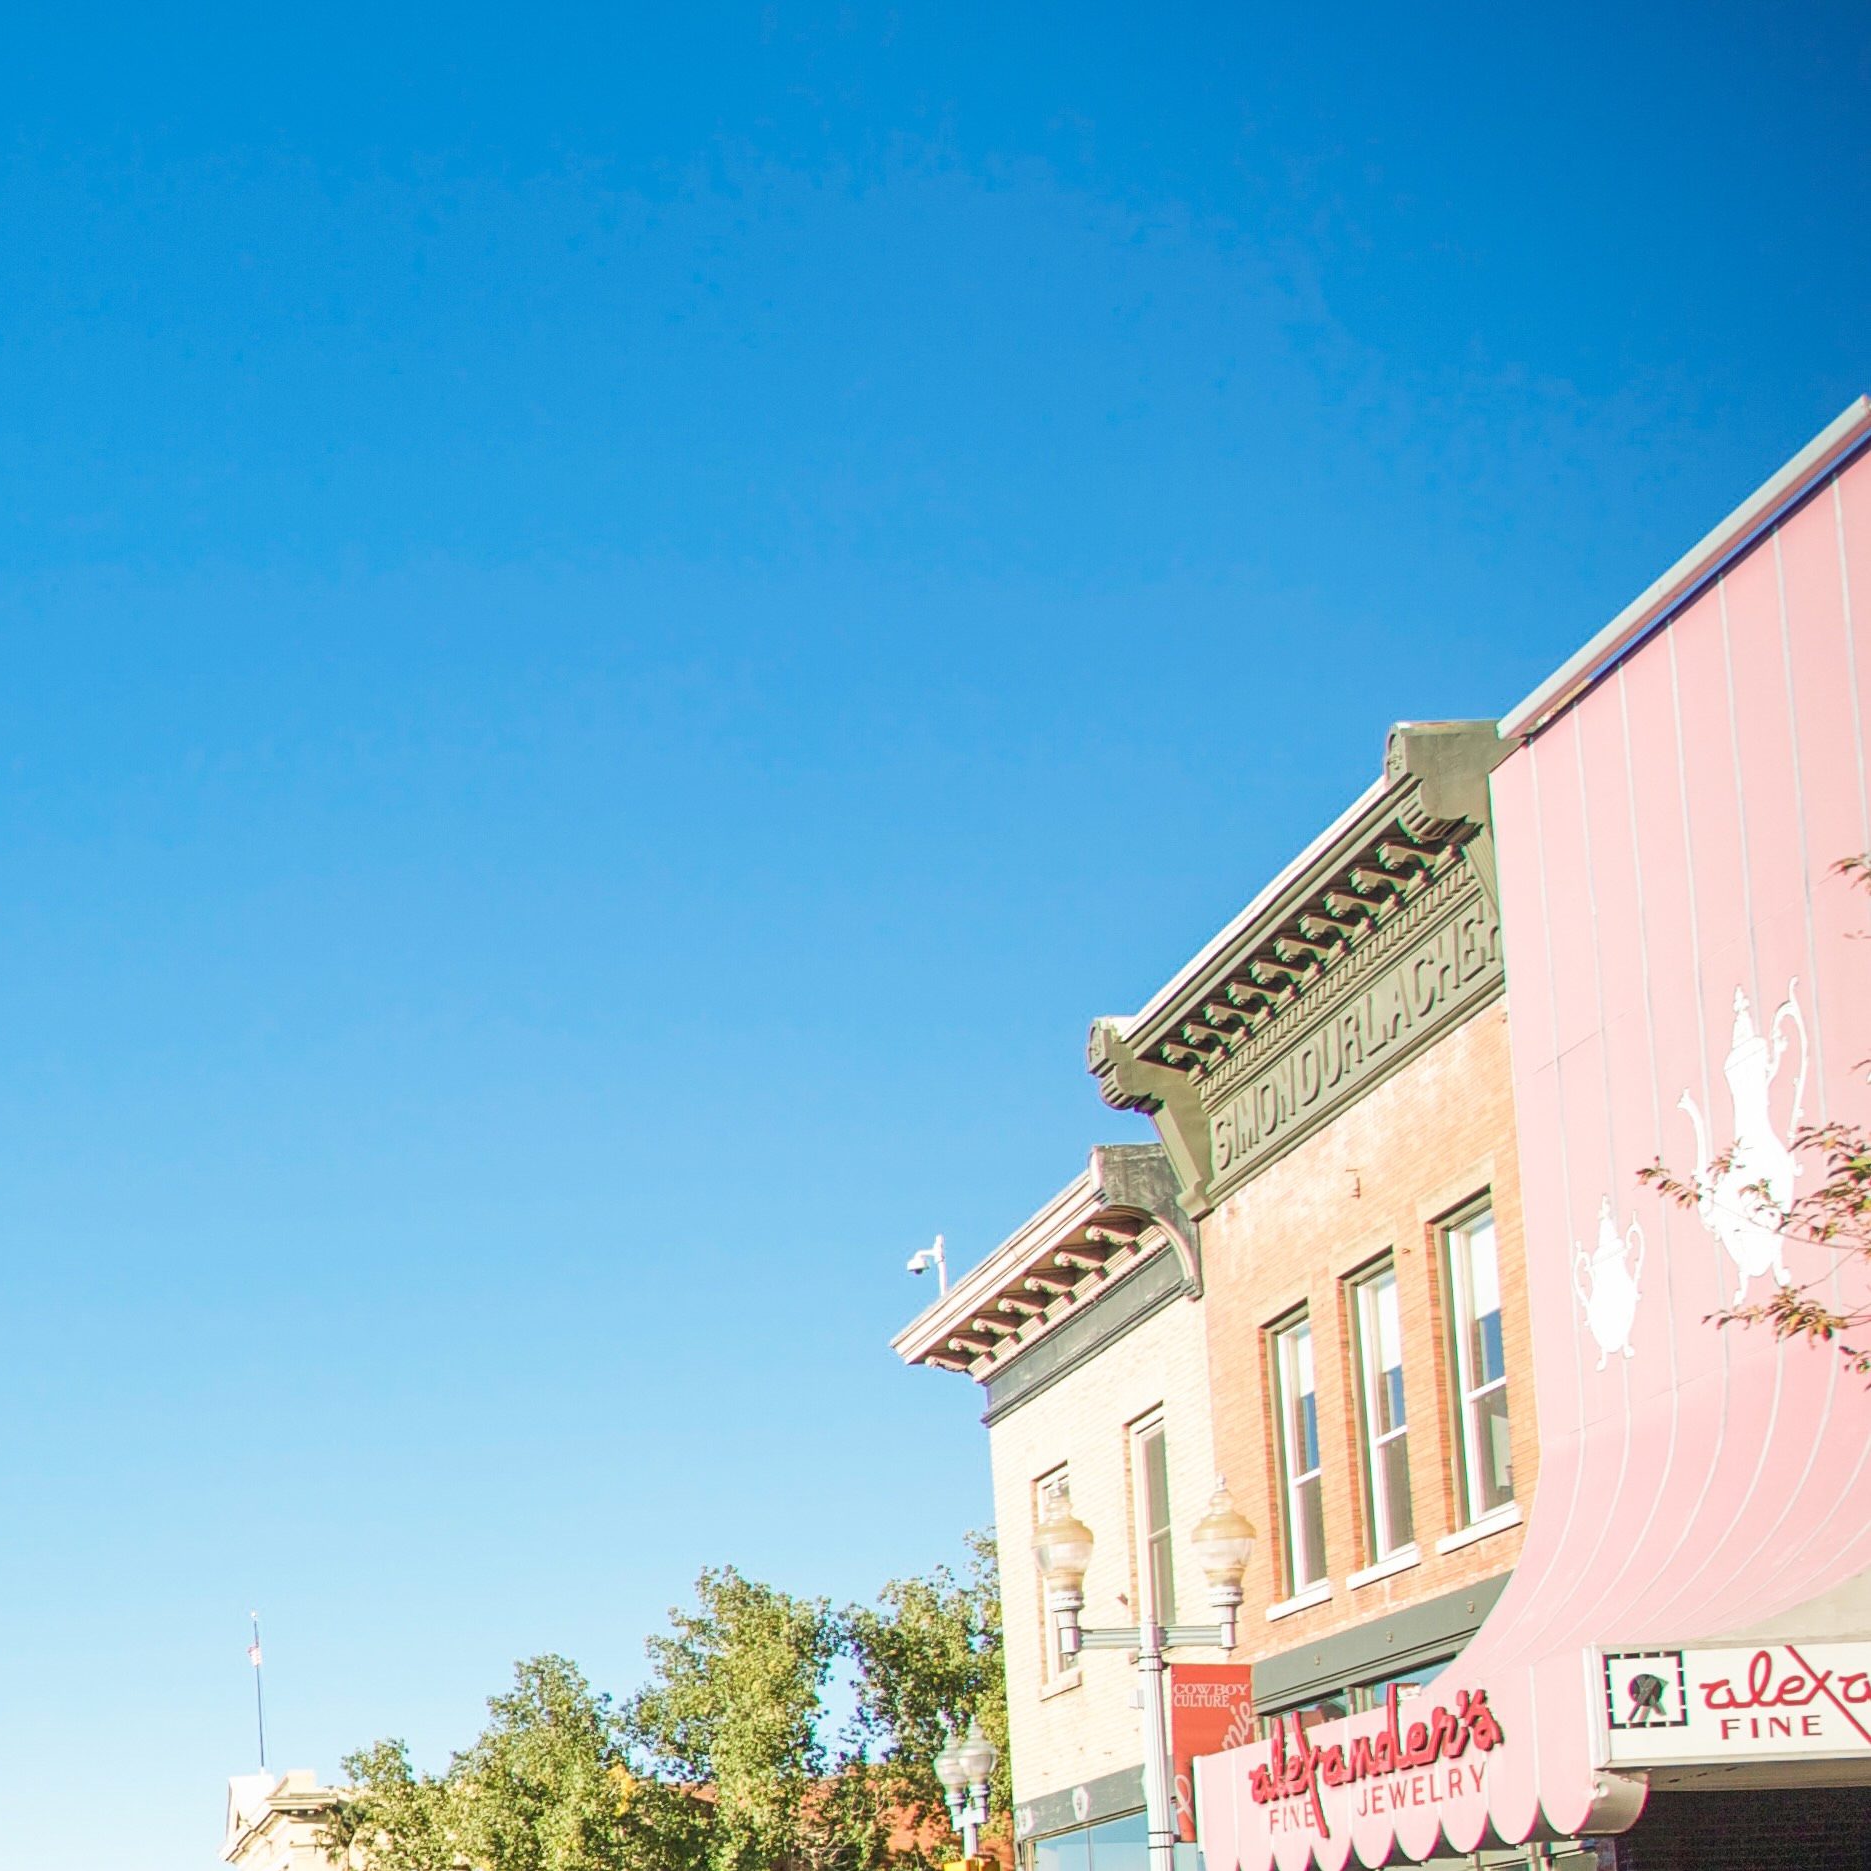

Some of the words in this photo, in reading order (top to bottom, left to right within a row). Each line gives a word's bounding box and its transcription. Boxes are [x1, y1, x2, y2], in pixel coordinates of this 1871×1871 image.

[1215, 1055, 1297, 1171] SIMON
[1174, 1684, 1249, 1696] COWBOY
[1174, 1695, 1230, 1708] CULTURE
[1721, 1715, 1823, 1740] FINE
[1249, 1683, 1504, 1838] alexander's
[1269, 1801, 1316, 1834] FINE
[1358, 1762, 1486, 1817] JEWELRY
